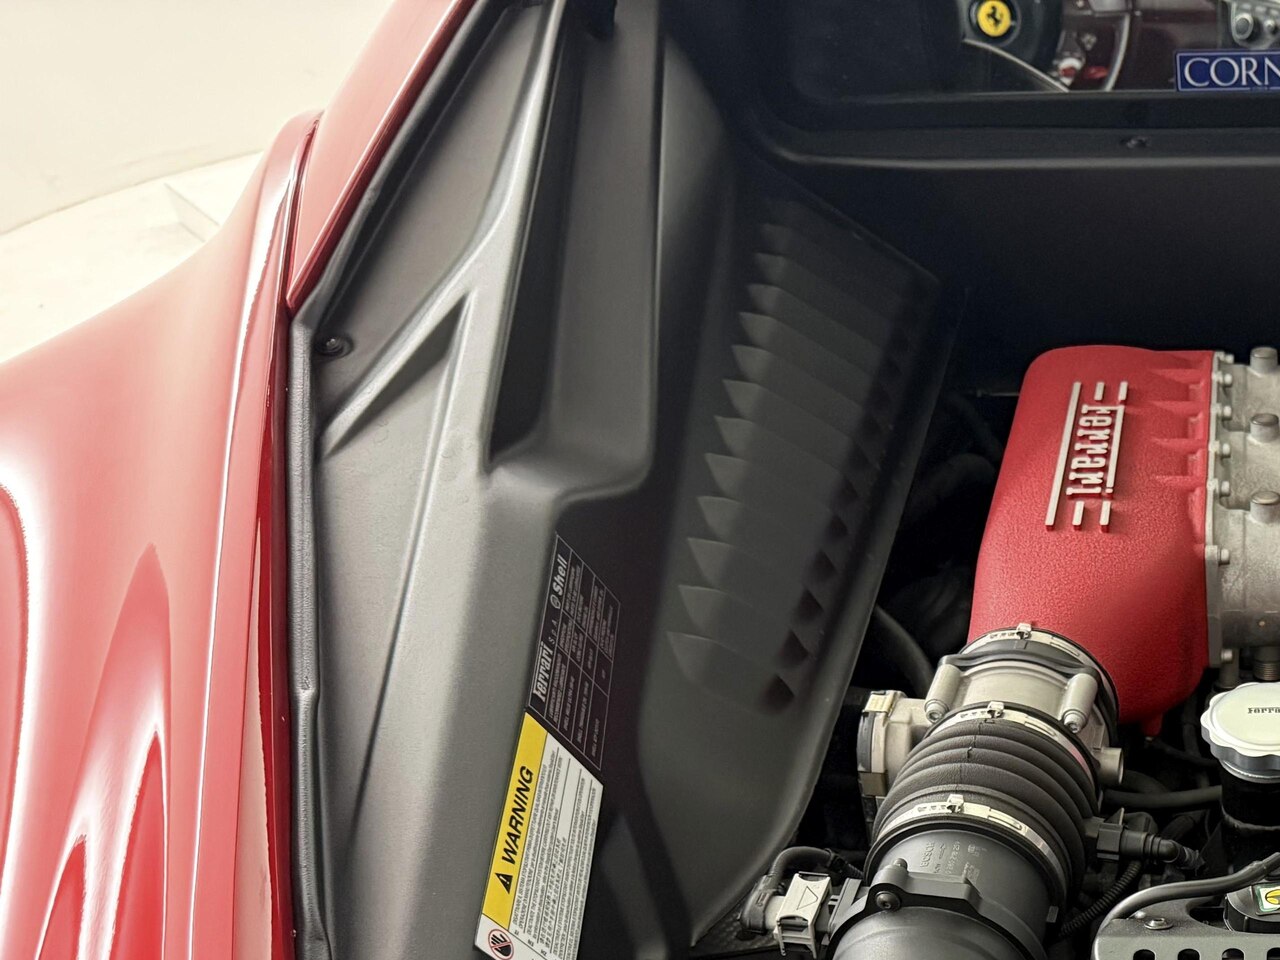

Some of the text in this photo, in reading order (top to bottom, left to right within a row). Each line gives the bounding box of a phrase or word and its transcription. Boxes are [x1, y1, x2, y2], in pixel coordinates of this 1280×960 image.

[1066, 404, 1125, 496] Ferrari
[552, 553, 568, 598] Shell
[533, 640, 554, 704] Ferrari
[501, 765, 535, 866] WARNING
